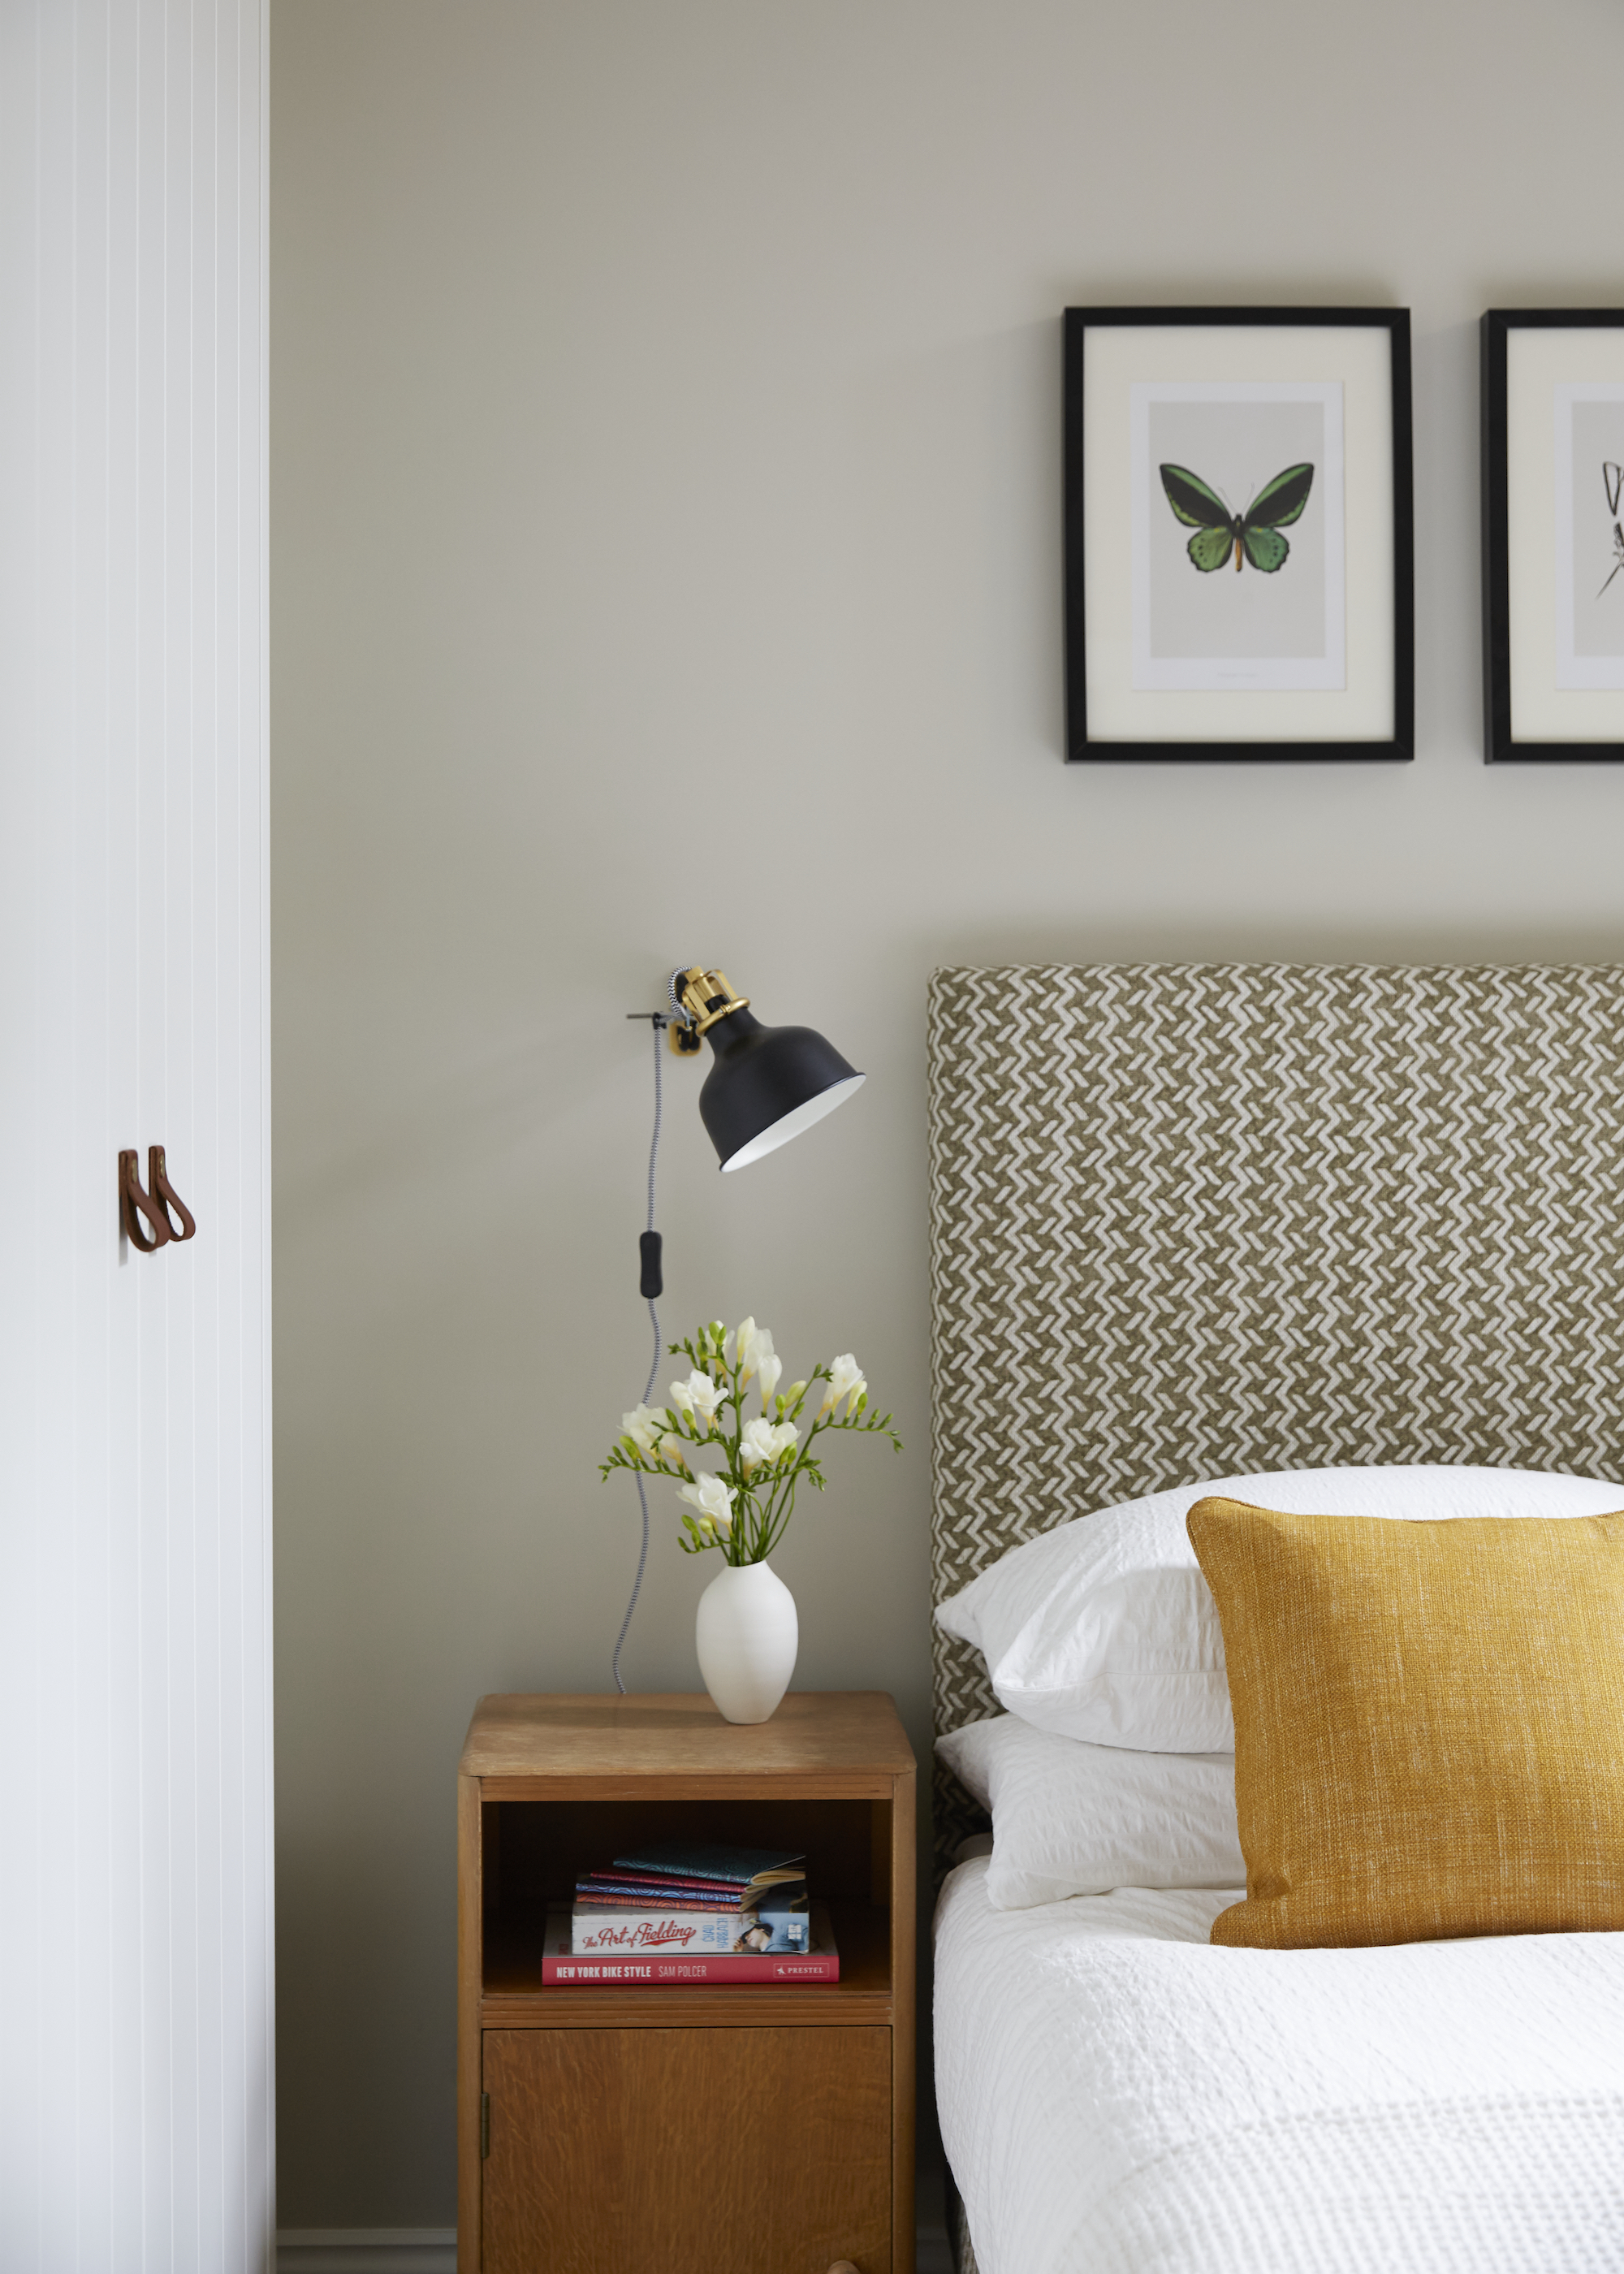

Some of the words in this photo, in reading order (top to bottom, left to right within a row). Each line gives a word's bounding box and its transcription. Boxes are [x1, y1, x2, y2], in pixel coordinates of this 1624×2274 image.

[582, 1936, 598, 1949] The
[598, 1927, 628, 1947] Art
[625, 1931, 637, 1948] of
[637, 1920, 697, 1947] Fielding
[702, 1925, 715, 1942] CHAD
[716, 1917, 728, 1948] HARBACH
[556, 1966, 575, 1978] NEW
[577, 1966, 600, 1978] YORK
[602, 1966, 622, 1978] BIKE
[624, 1966, 651, 1978] STYLE
[659, 1965, 676, 1978] SAM
[677, 1965, 707, 1978] POLCER
